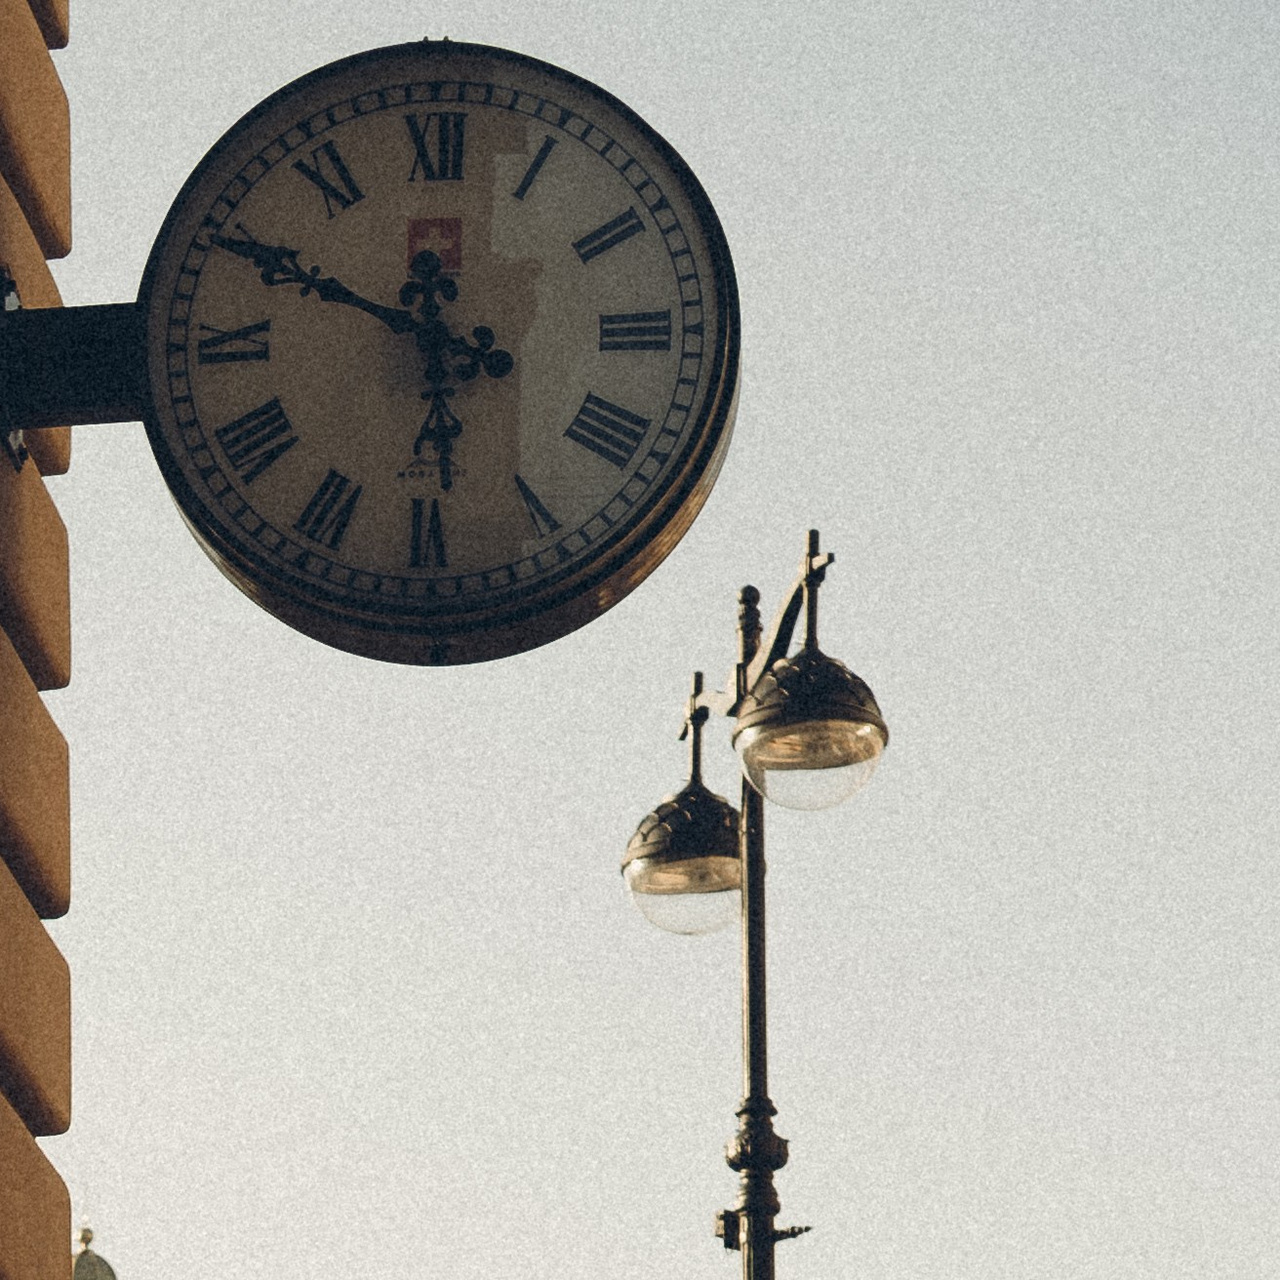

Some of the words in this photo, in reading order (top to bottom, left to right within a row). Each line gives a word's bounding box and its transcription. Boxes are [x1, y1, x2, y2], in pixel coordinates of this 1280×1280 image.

[291, 140, 365, 220] XI
[404, 112, 467, 181] XII
[512, 135, 559, 201] I
[573, 207, 647, 264] II
[197, 320, 271, 365] IX
[599, 309, 672, 352] III
[215, 397, 299, 486] VIII
[565, 392, 653, 471] IIII
[293, 469, 363, 551] VII
[408, 498, 448, 568] VI
[513, 474, 562, 540] V
